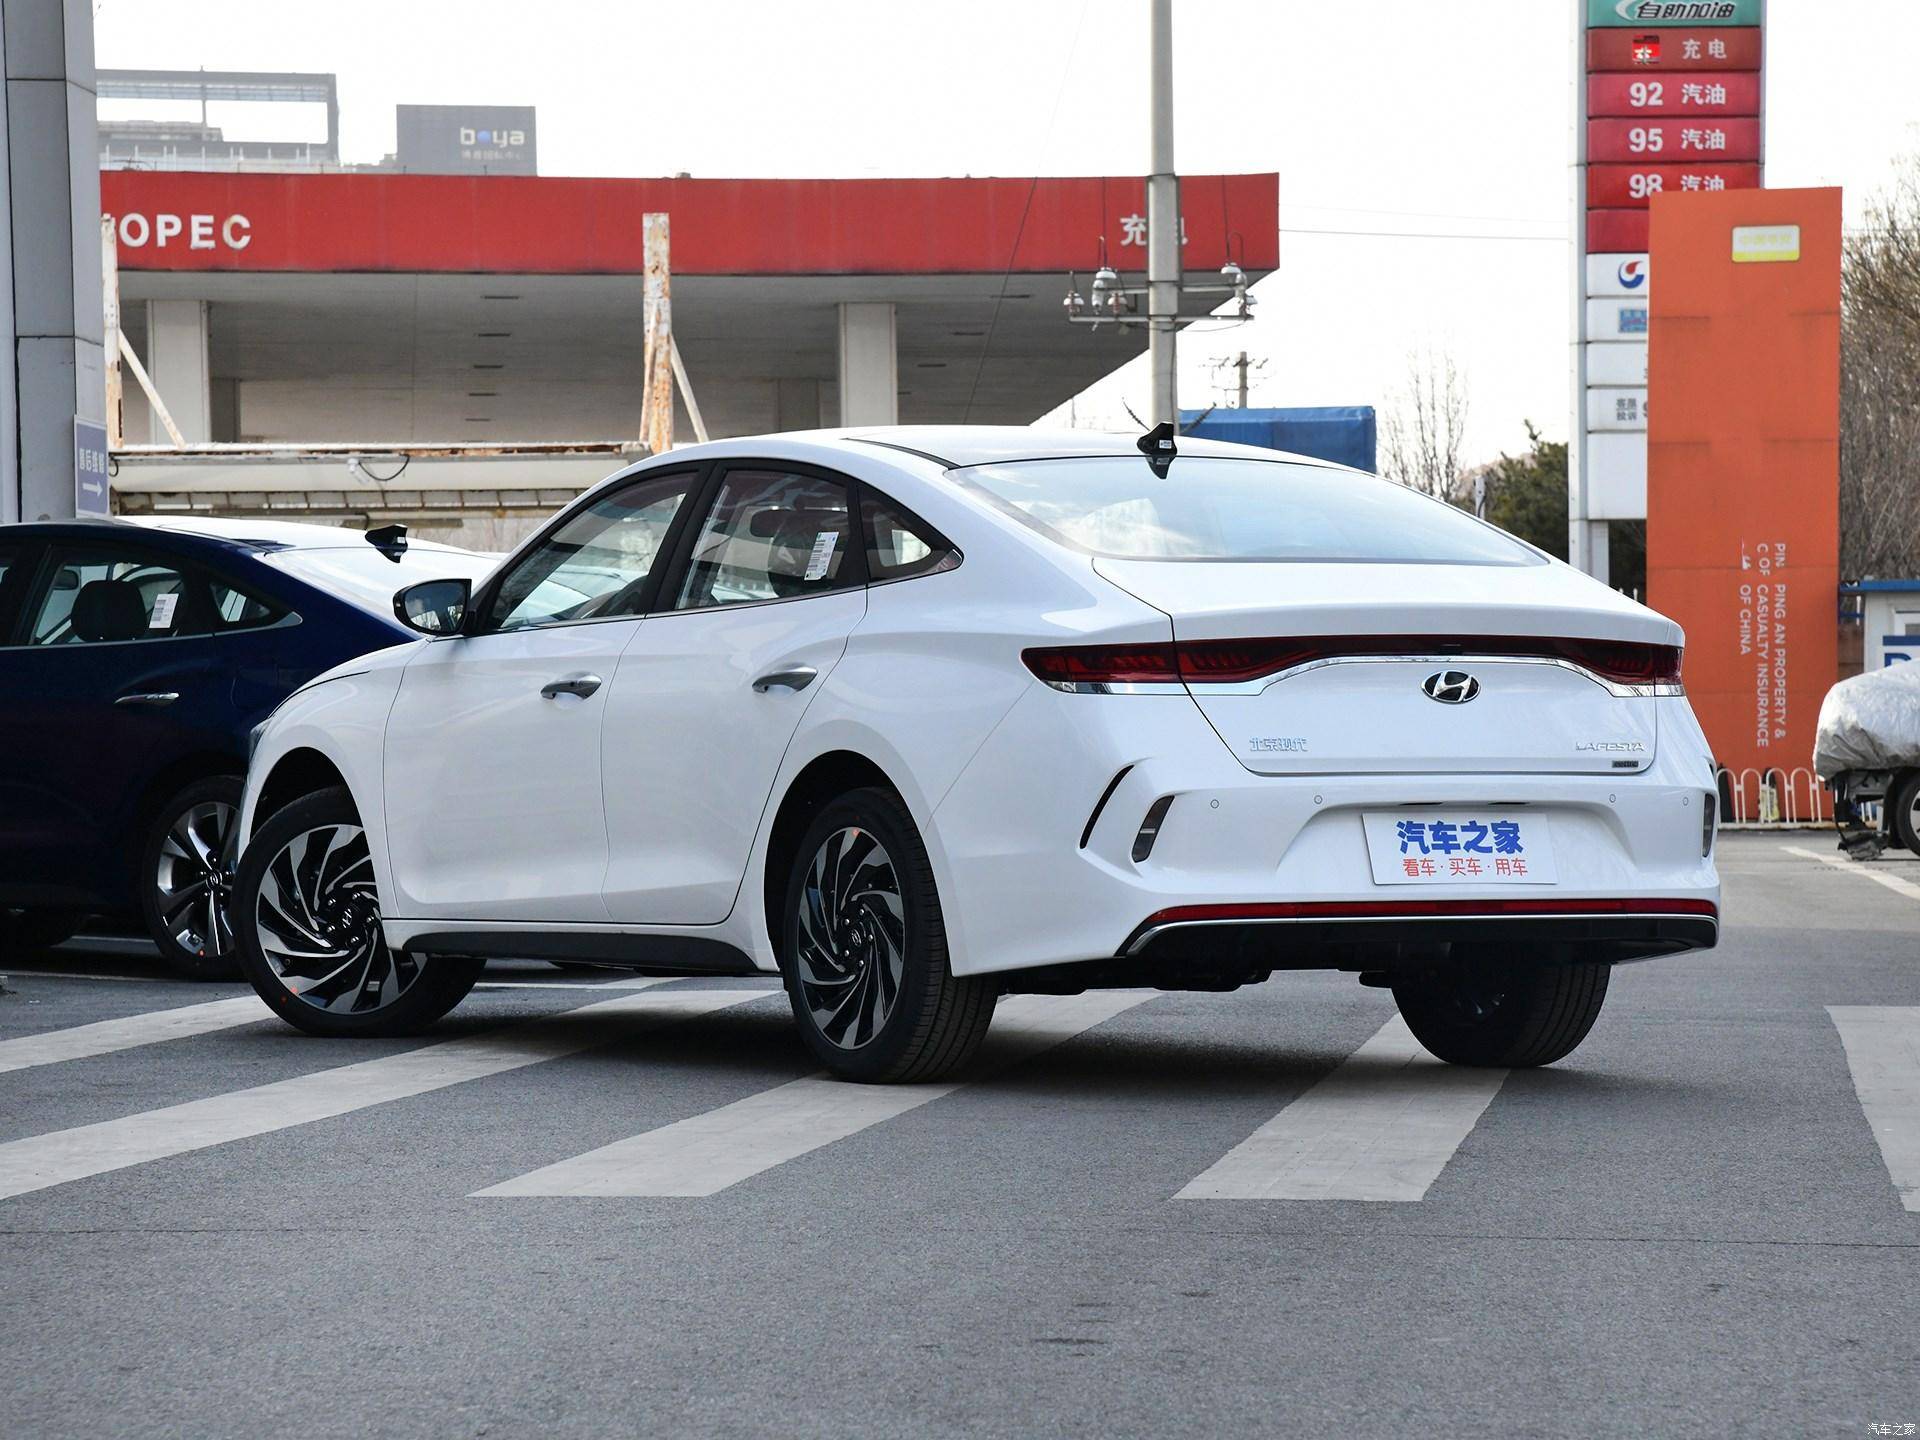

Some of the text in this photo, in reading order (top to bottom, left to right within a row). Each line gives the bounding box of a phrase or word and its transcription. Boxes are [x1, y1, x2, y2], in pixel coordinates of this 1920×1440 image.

[1682, 38, 1727, 60] 充电
[1629, 82, 1726, 107] 92 汽油
[1629, 128, 1726, 152] 95 汽油
[1629, 174, 1663, 199] 98
[115, 213, 251, 250] OPEC
[1774, 584, 1786, 619] PING
[1740, 584, 1751, 655] OF CHINA
[1774, 623, 1786, 645] AN
[1757, 584, 1769, 747] CASUALTY INSURANCE
[1774, 648, 1786, 725] PROPERTY
[1575, 742, 1645, 752] LAFESTA
[1397, 820, 1523, 855] 汽车之家
